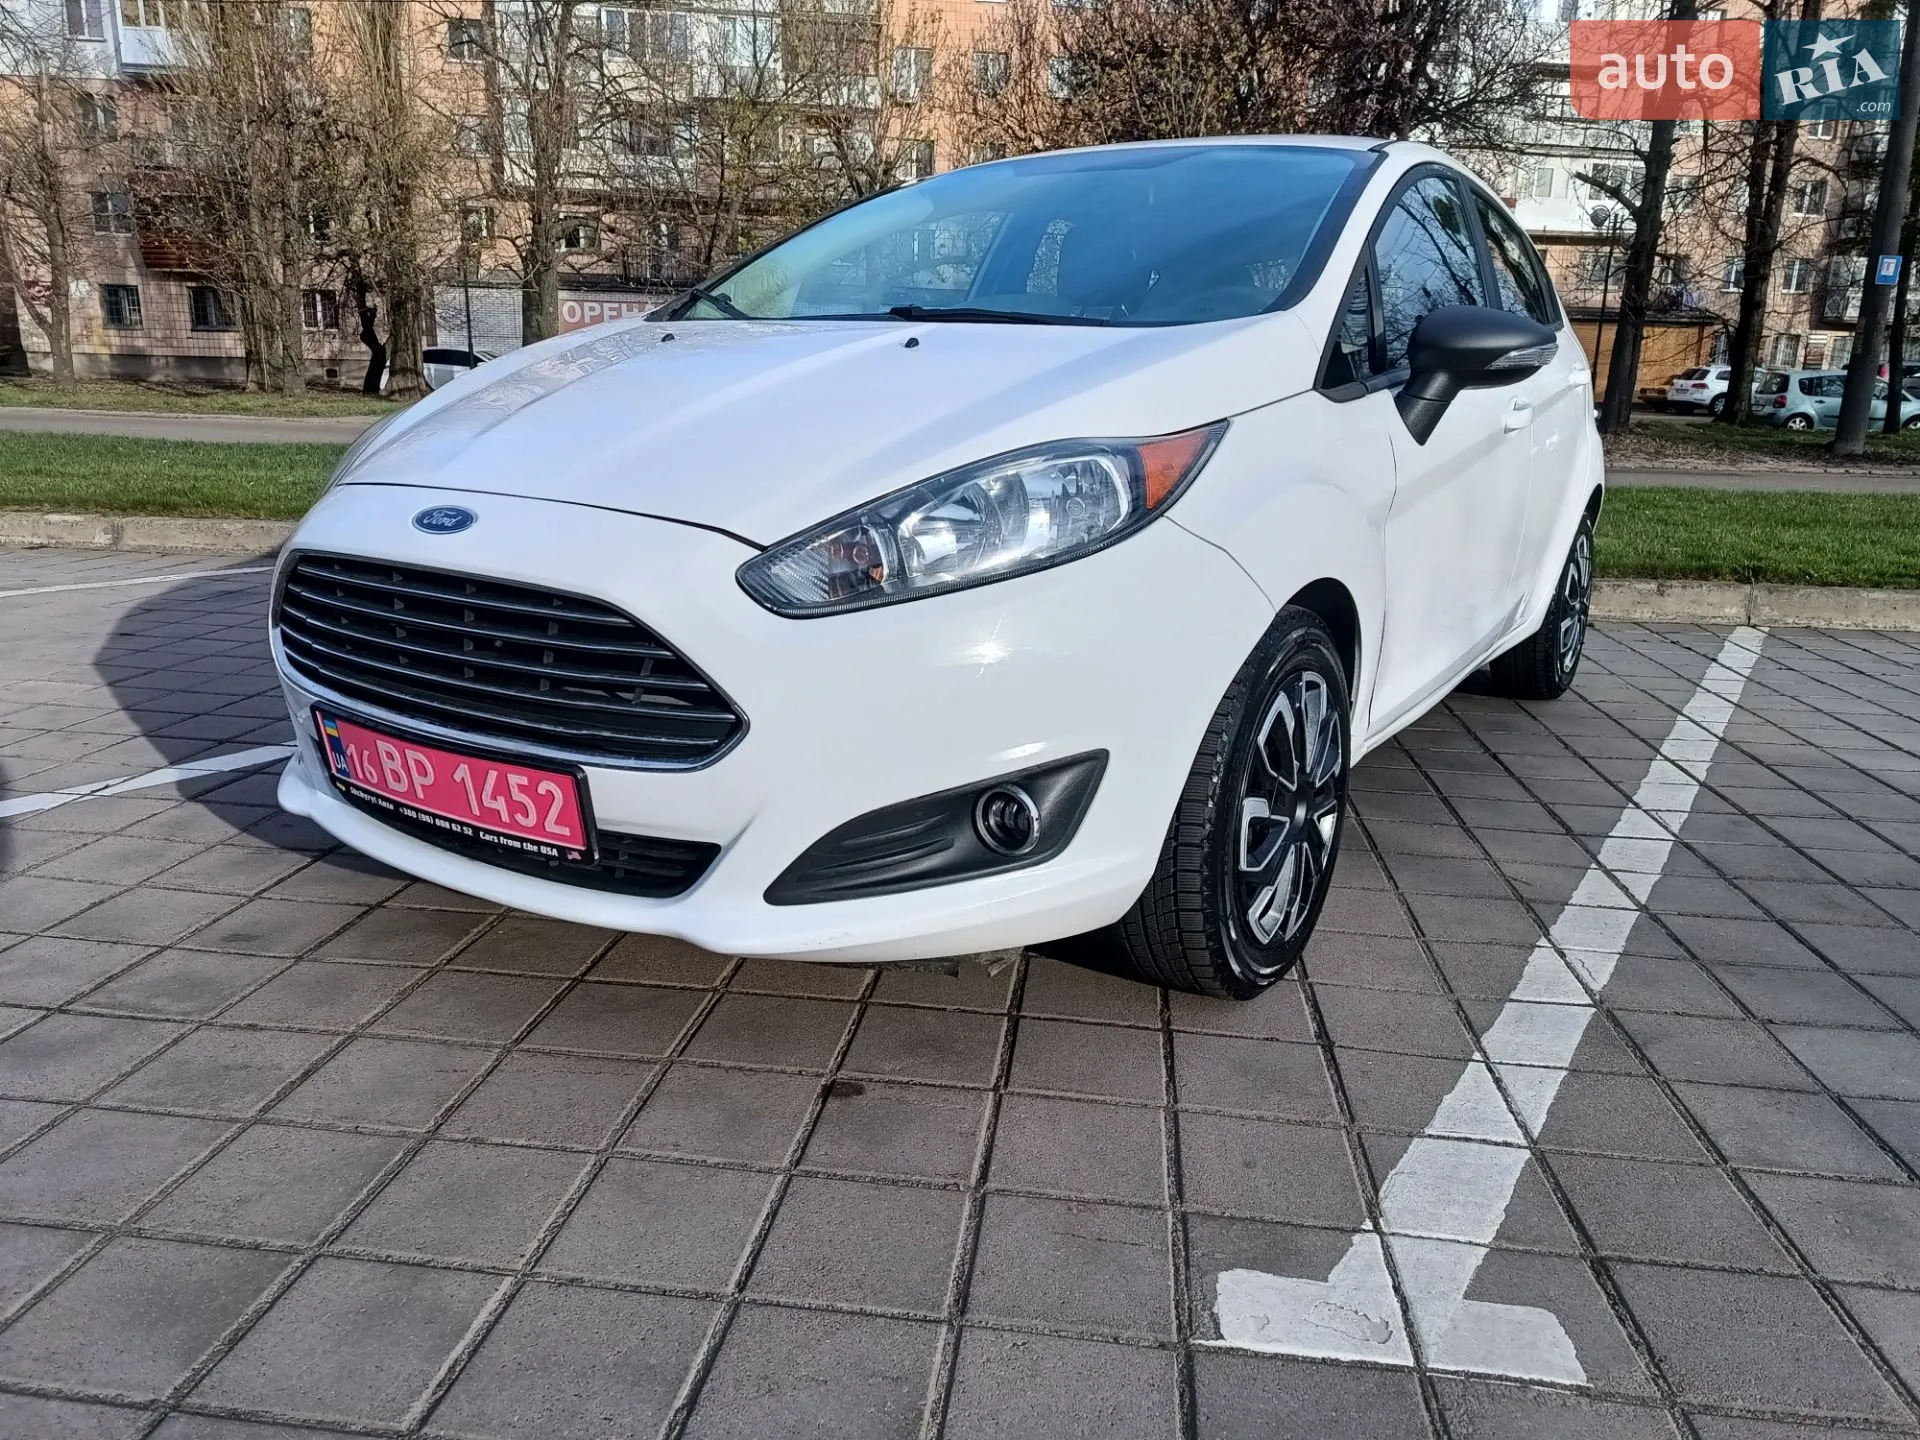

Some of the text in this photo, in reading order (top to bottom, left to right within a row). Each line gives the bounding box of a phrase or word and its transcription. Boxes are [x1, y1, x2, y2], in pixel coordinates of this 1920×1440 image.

[562, 300, 655, 324] ОРЕН
[423, 509, 462, 527] Ford
[333, 751, 349, 773] UA
[453, 763, 571, 837] 1452
[378, 798, 395, 811] Auto
[398, 807, 417, 819] +380
[463, 826, 474, 837] 52
[479, 831, 499, 844] Cars
[500, 836, 522, 849] from
[522, 841, 539, 853] the
[540, 845, 559, 858] USA
